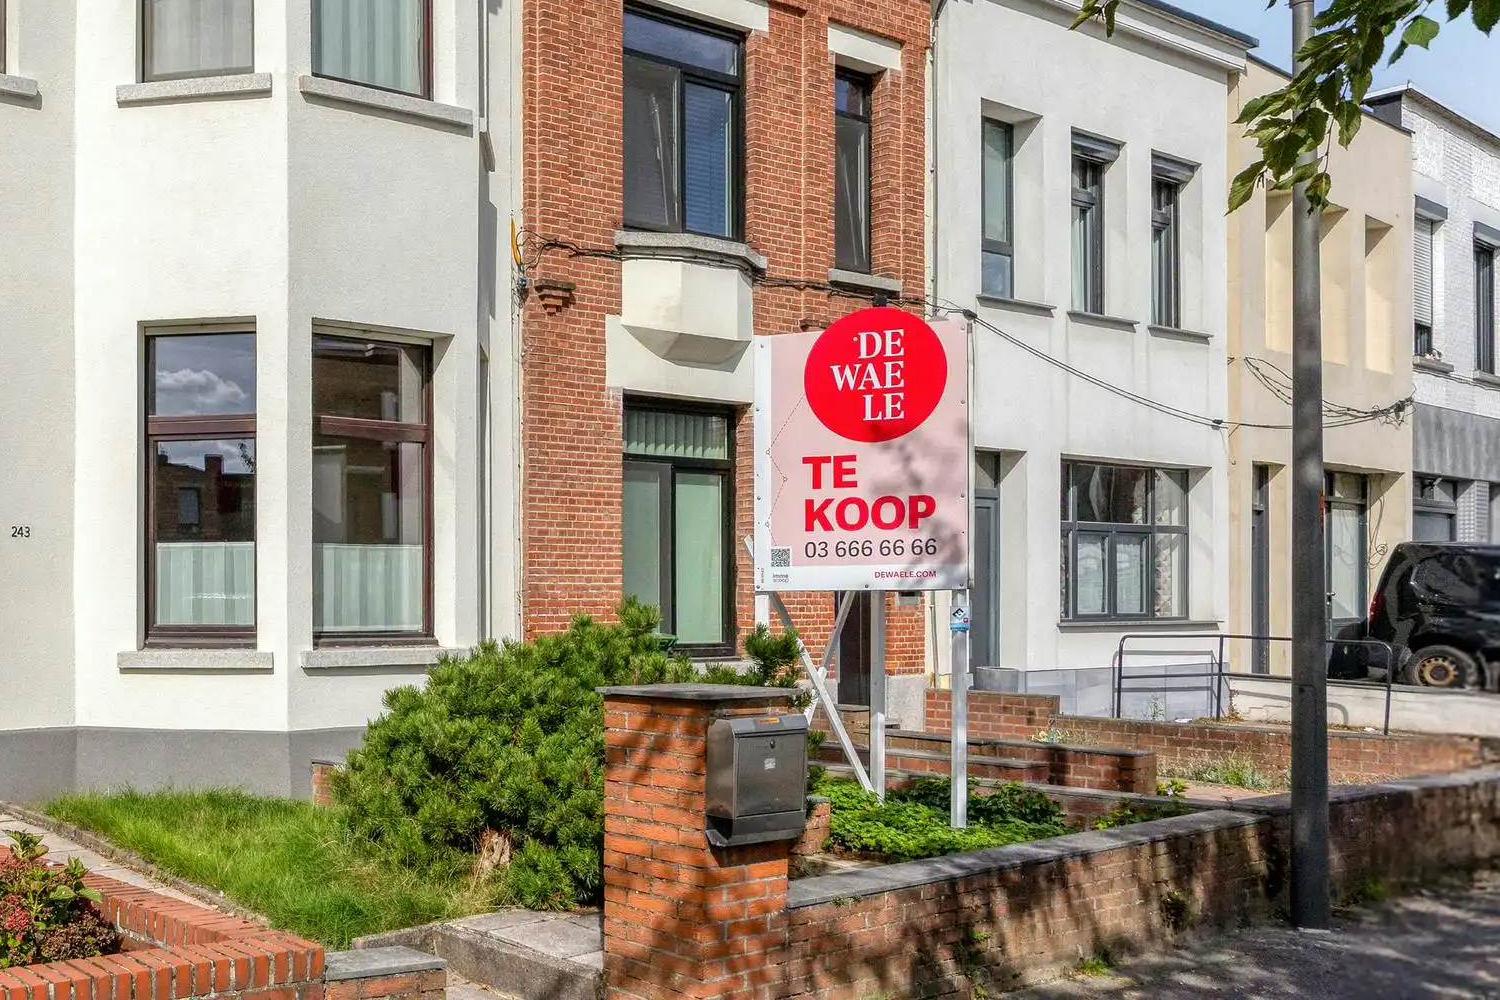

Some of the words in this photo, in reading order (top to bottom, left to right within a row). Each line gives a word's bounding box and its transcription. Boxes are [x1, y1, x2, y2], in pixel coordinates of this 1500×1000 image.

[858, 329, 905, 359] DE
[830, 361, 905, 392] WAE
[862, 394, 905, 421] LE
[802, 455, 858, 490] TE
[804, 495, 936, 532] KOOP
[11, 526, 31, 538] 243
[804, 541, 829, 559] 03
[835, 540, 873, 558] 666
[879, 539, 905, 557] 66
[911, 538, 937, 556] 66
[874, 570, 937, 578] DEWAELE.COM
